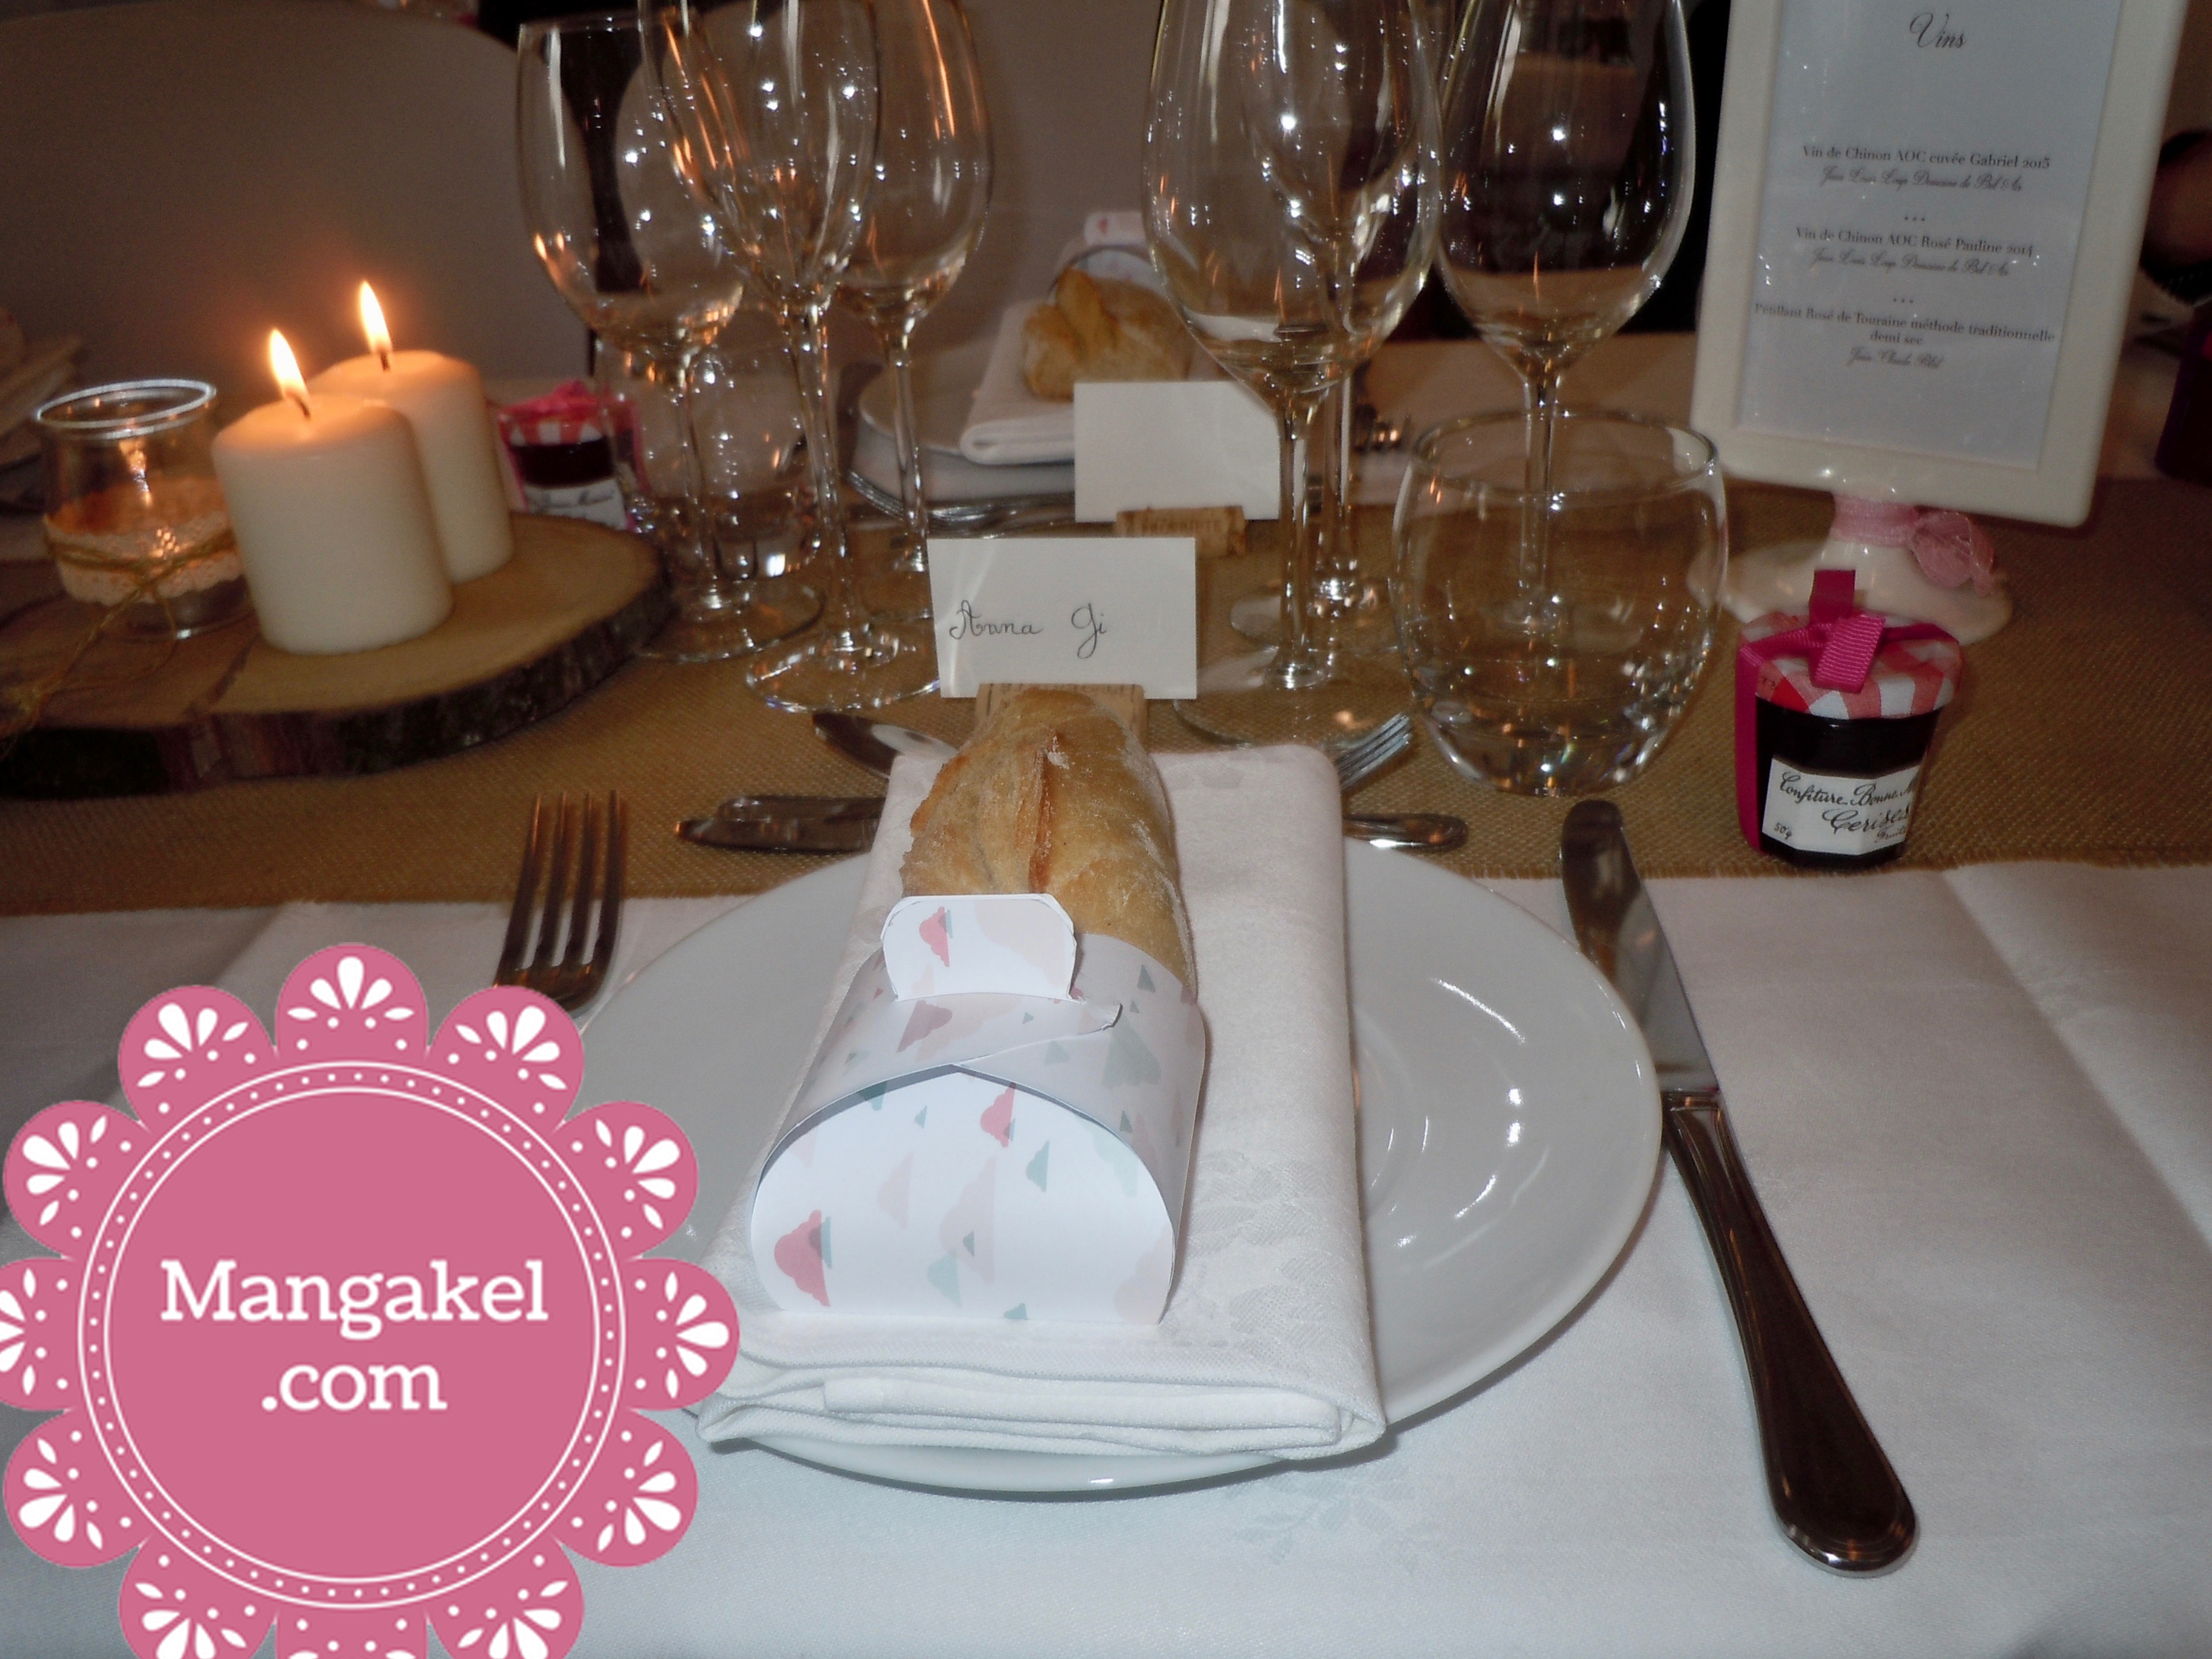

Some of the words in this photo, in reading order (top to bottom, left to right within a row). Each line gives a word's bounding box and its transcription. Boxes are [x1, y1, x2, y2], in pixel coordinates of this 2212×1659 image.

[1909, 13, 1967, 49] Vins
[1803, 145, 1823, 158] Vin
[1827, 146, 1841, 159] de
[1845, 147, 1891, 161] Chinon
[1897, 150, 1926, 163] AOC
[1929, 153, 1965, 165] cuvée
[1970, 153, 2018, 168] Gabriel
[2022, 156, 2050, 169] 2015
[1796, 227, 1816, 240] Vin
[1819, 229, 1835, 241] de
[1838, 230, 1883, 244] Chinon
[1888, 233, 1918, 247] AOC
[1921, 235, 1951, 249] Rosé
[1955, 238, 2003, 253] Pauline
[2006, 245, 2034, 258] 2014
[1806, 307, 1834, 322] Rosé
[1837, 309, 1852, 323] de
[1855, 311, 1907, 328] Touraine
[1910, 318, 1965, 334] méthode
[1969, 325, 2055, 342] traditionnelle
[1870, 330, 1901, 344] demi
[1903, 336, 1923, 346] sec
[1779, 771, 1847, 804] Confiture
[1850, 783, 1898, 807] Bonne
